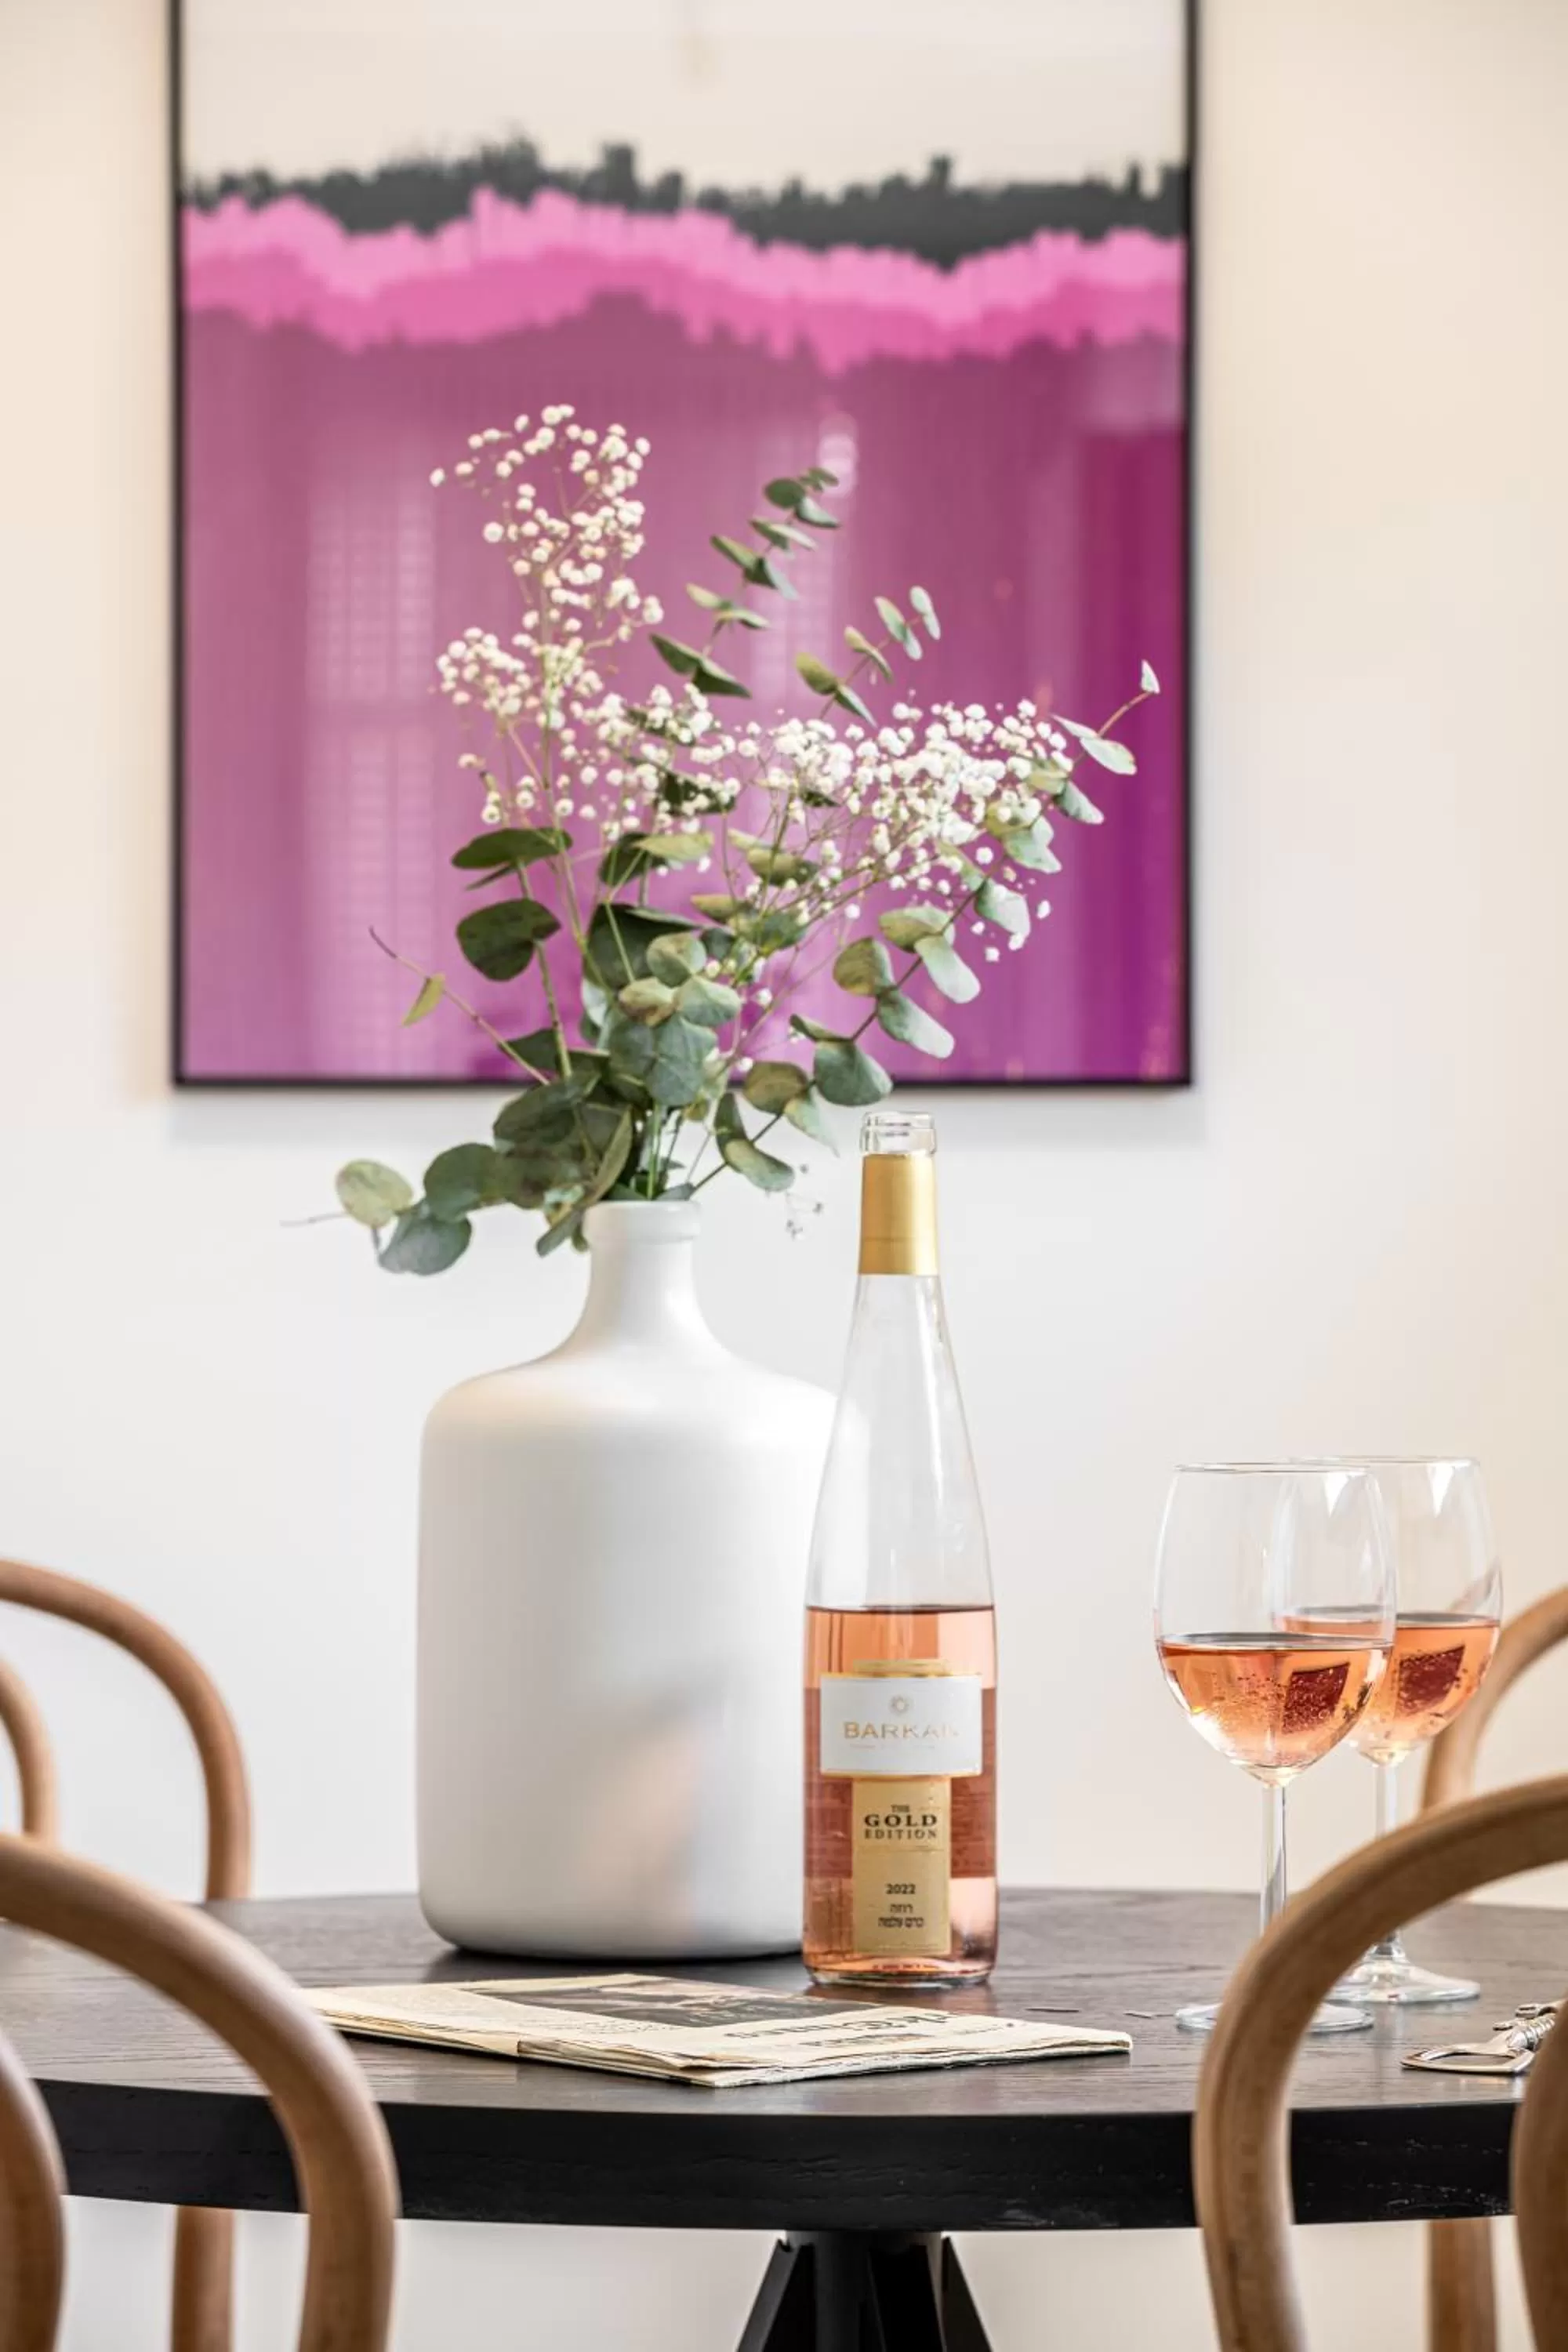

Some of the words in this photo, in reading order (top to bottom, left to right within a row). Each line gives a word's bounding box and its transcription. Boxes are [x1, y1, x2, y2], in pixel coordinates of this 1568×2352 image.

[864, 1813, 937, 1828] GOLD
[864, 1829, 937, 1840] EDITION
[886, 1883, 916, 1895] 2022
